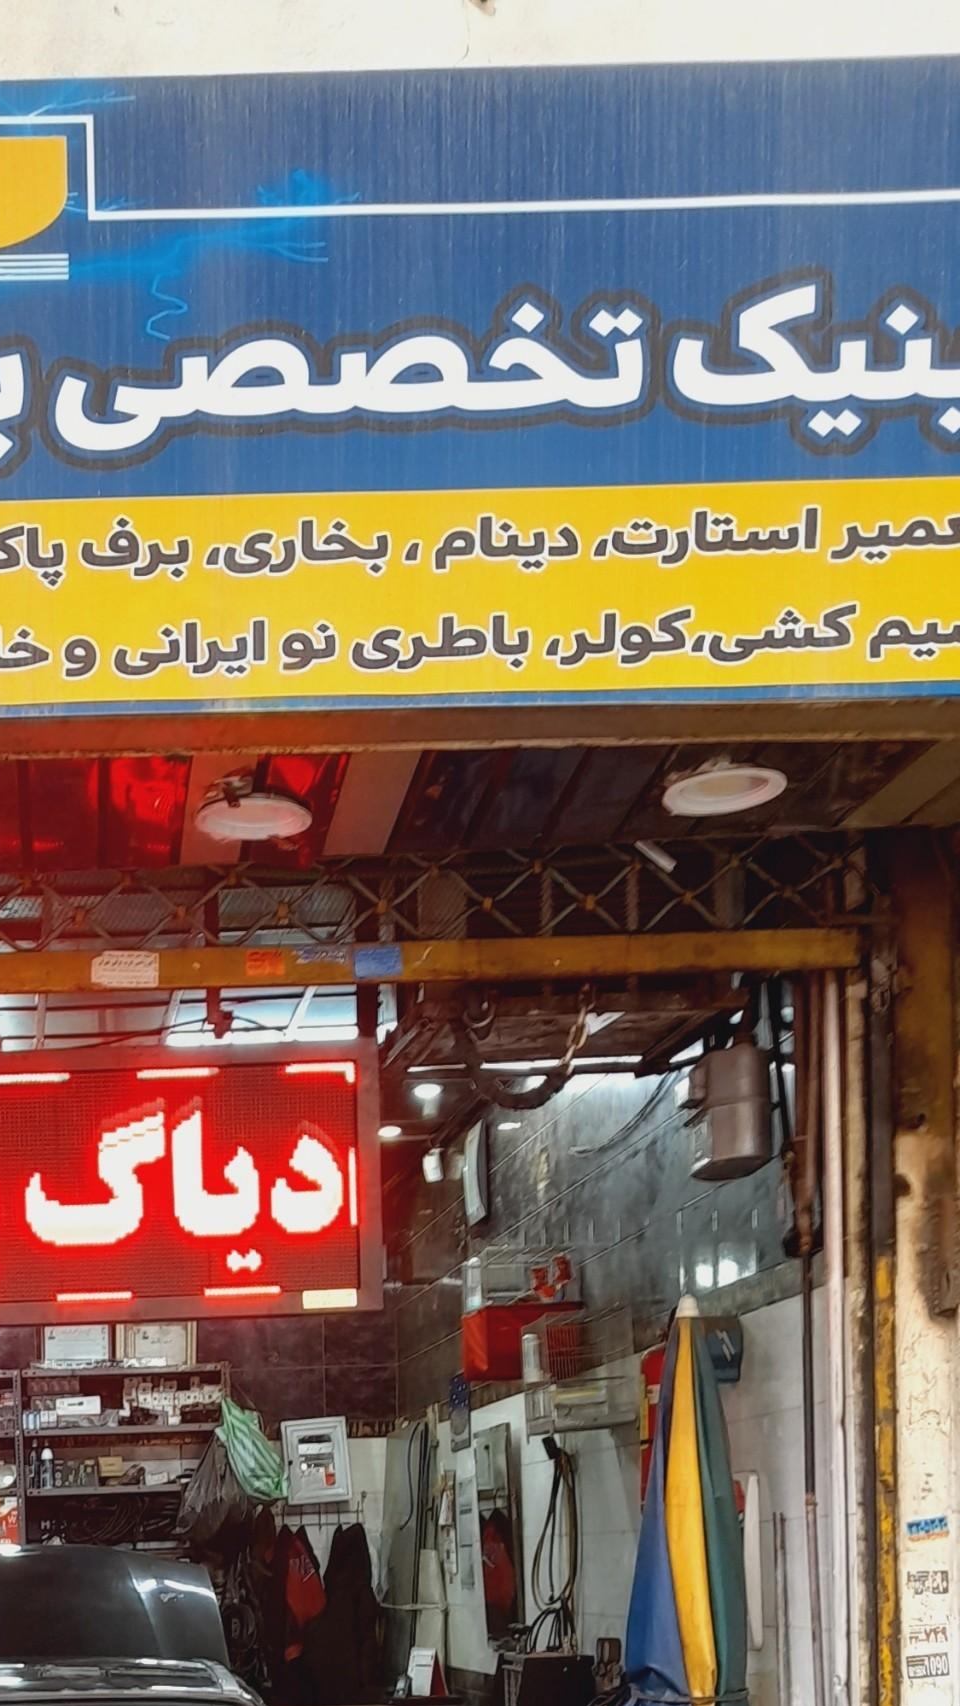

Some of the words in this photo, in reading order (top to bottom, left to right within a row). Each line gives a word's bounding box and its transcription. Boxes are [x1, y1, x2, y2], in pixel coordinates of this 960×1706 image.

[55, 302, 643, 452] تخصصی
[81, 517, 190, 578] برف
[206, 519, 389, 574] بخاری،
[593, 508, 818, 565] استارت،
[64, 638, 97, 677] و
[114, 620, 265, 676] ایرانی
[282, 623, 336, 670] نو
[352, 615, 529, 670] باطری
[25, 1110, 343, 1271] دیاگ
